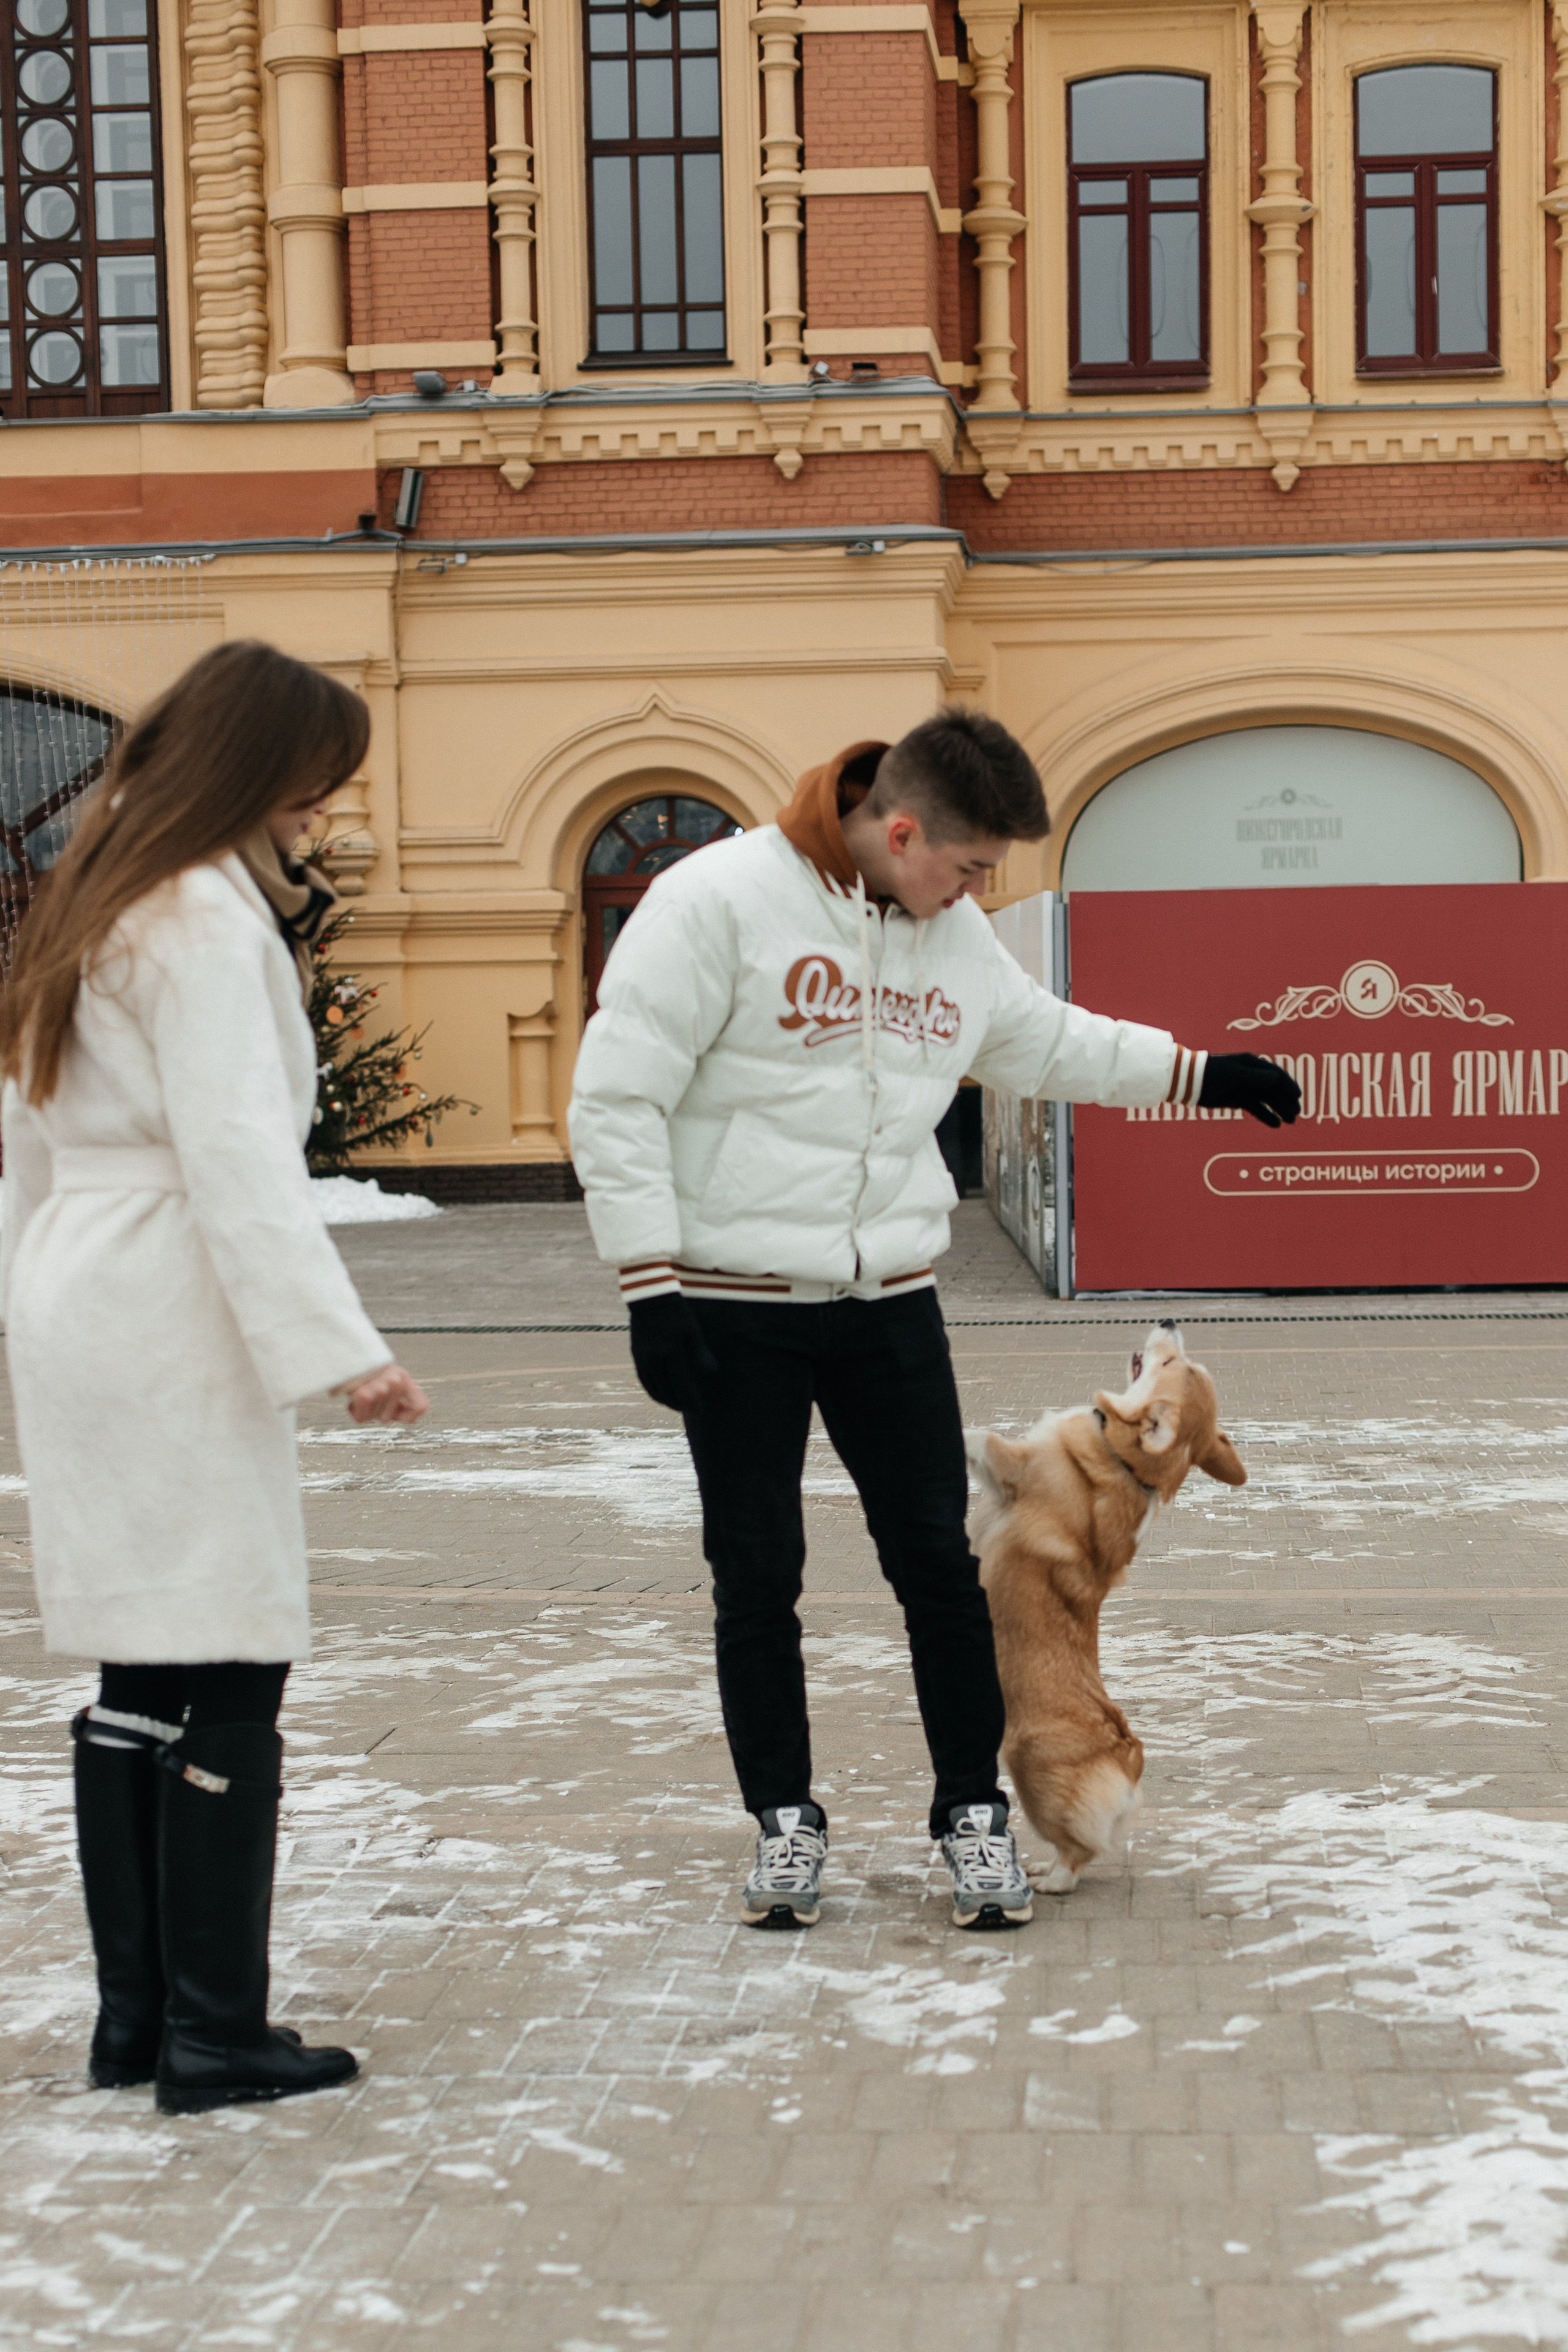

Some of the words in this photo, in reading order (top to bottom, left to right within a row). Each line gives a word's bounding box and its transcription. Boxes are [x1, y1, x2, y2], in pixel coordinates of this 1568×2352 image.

[1360, 978, 1378, 1000] Я
[1452, 1049, 1568, 1117] ЯРМАР
[1259, 1165, 1379, 1187] страницы
[1385, 1163, 1485, 1185] истории
